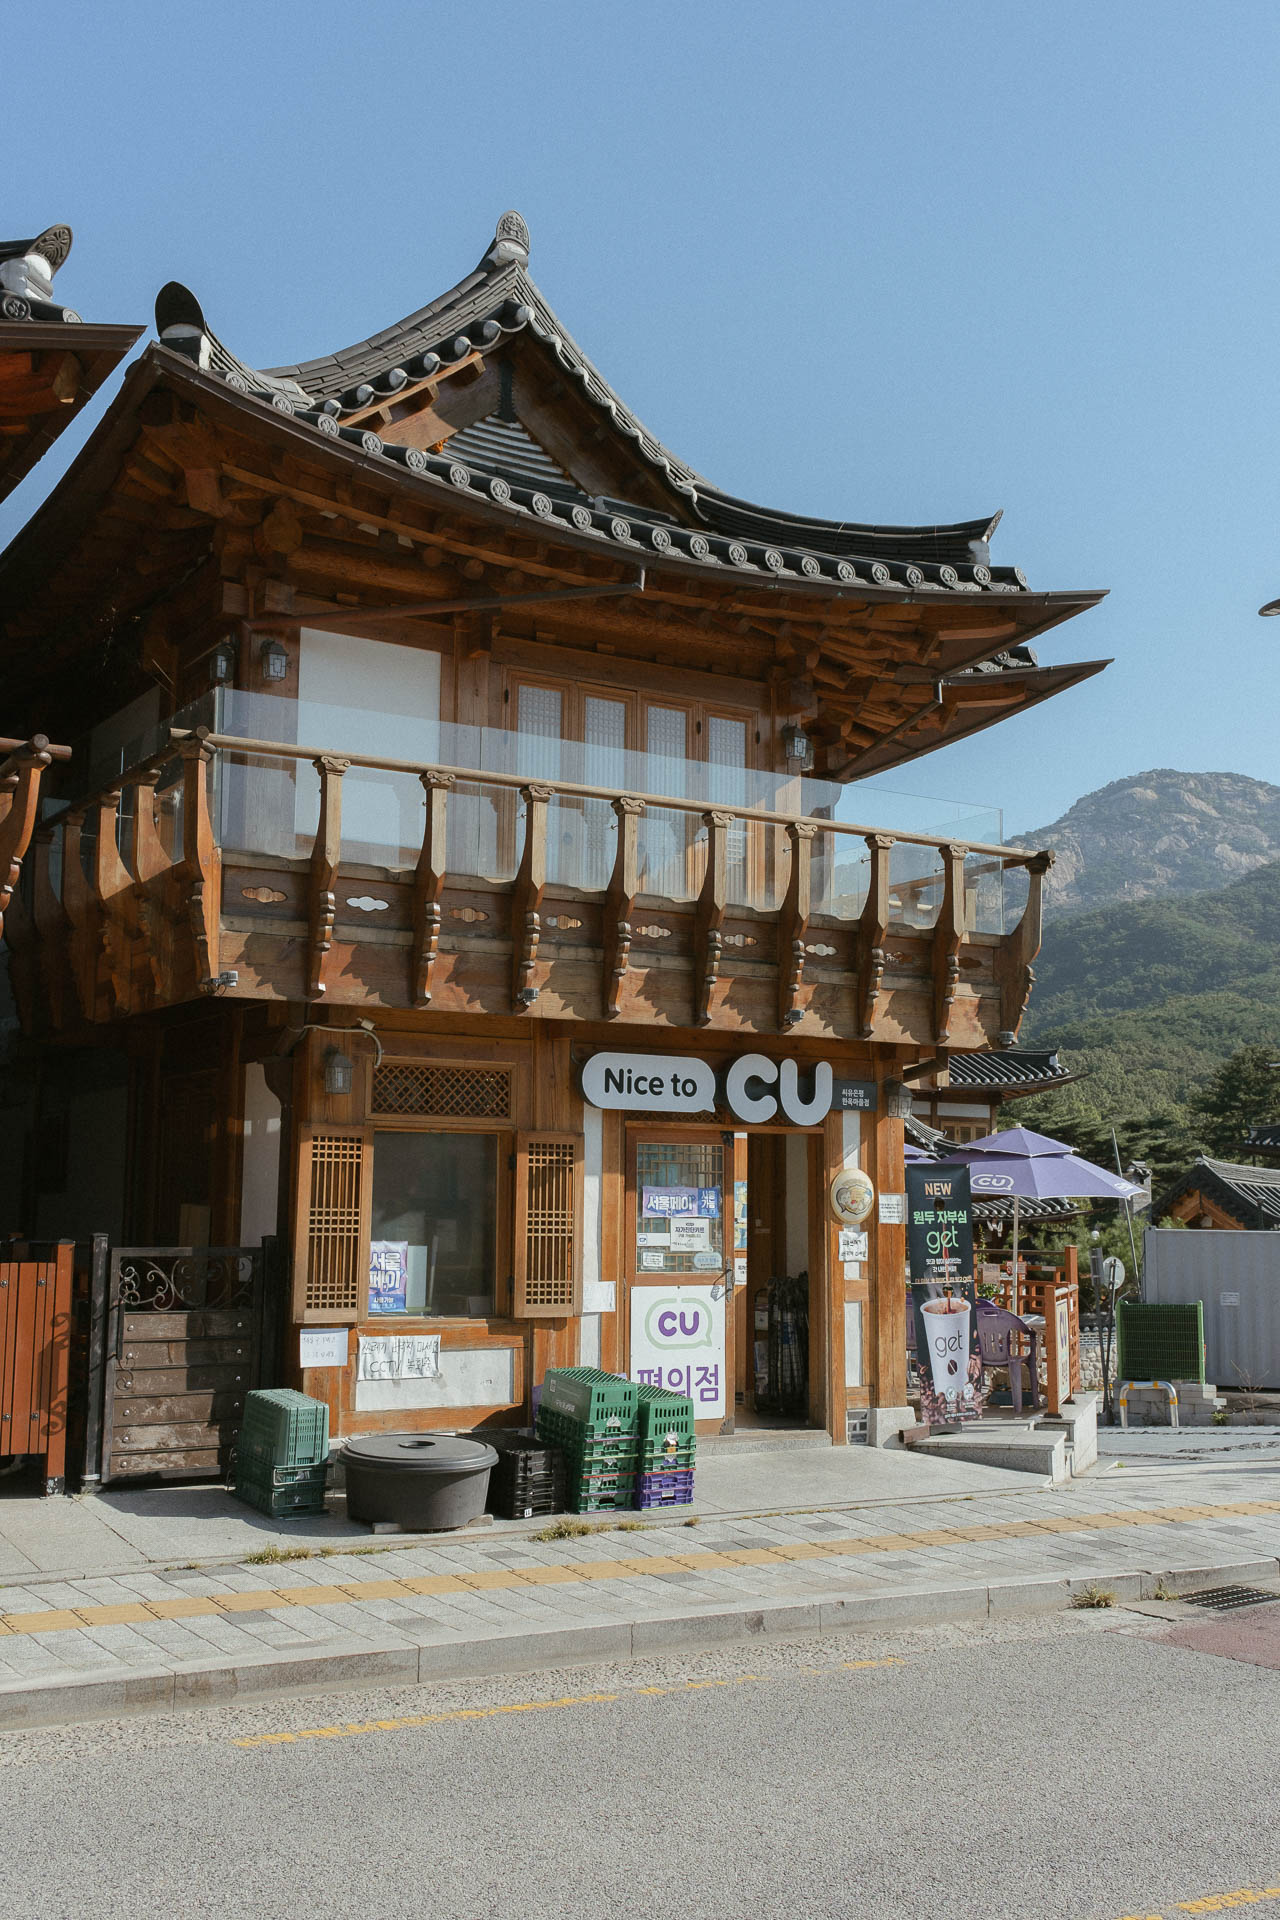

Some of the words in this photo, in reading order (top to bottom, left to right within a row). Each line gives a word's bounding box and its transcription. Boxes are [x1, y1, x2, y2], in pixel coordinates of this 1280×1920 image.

[604, 1068, 664, 1097] Nice
[671, 1073, 698, 1098] to
[726, 1053, 833, 1126] CU
[841, 1097, 870, 1107] 한옥마을점
[924, 1182, 952, 1196] NEW
[978, 1177, 1006, 1187] CU
[647, 1194, 693, 1211] 서울페이
[913, 1210, 936, 1224] 원두
[936, 1210, 968, 1224] 자부심
[675, 1226, 705, 1234] 자가진단키트
[926, 1225, 959, 1254] get
[369, 1252, 401, 1271] 서울
[368, 1270, 401, 1288] 페이
[658, 1310, 700, 1337] CU
[935, 1329, 963, 1358] get
